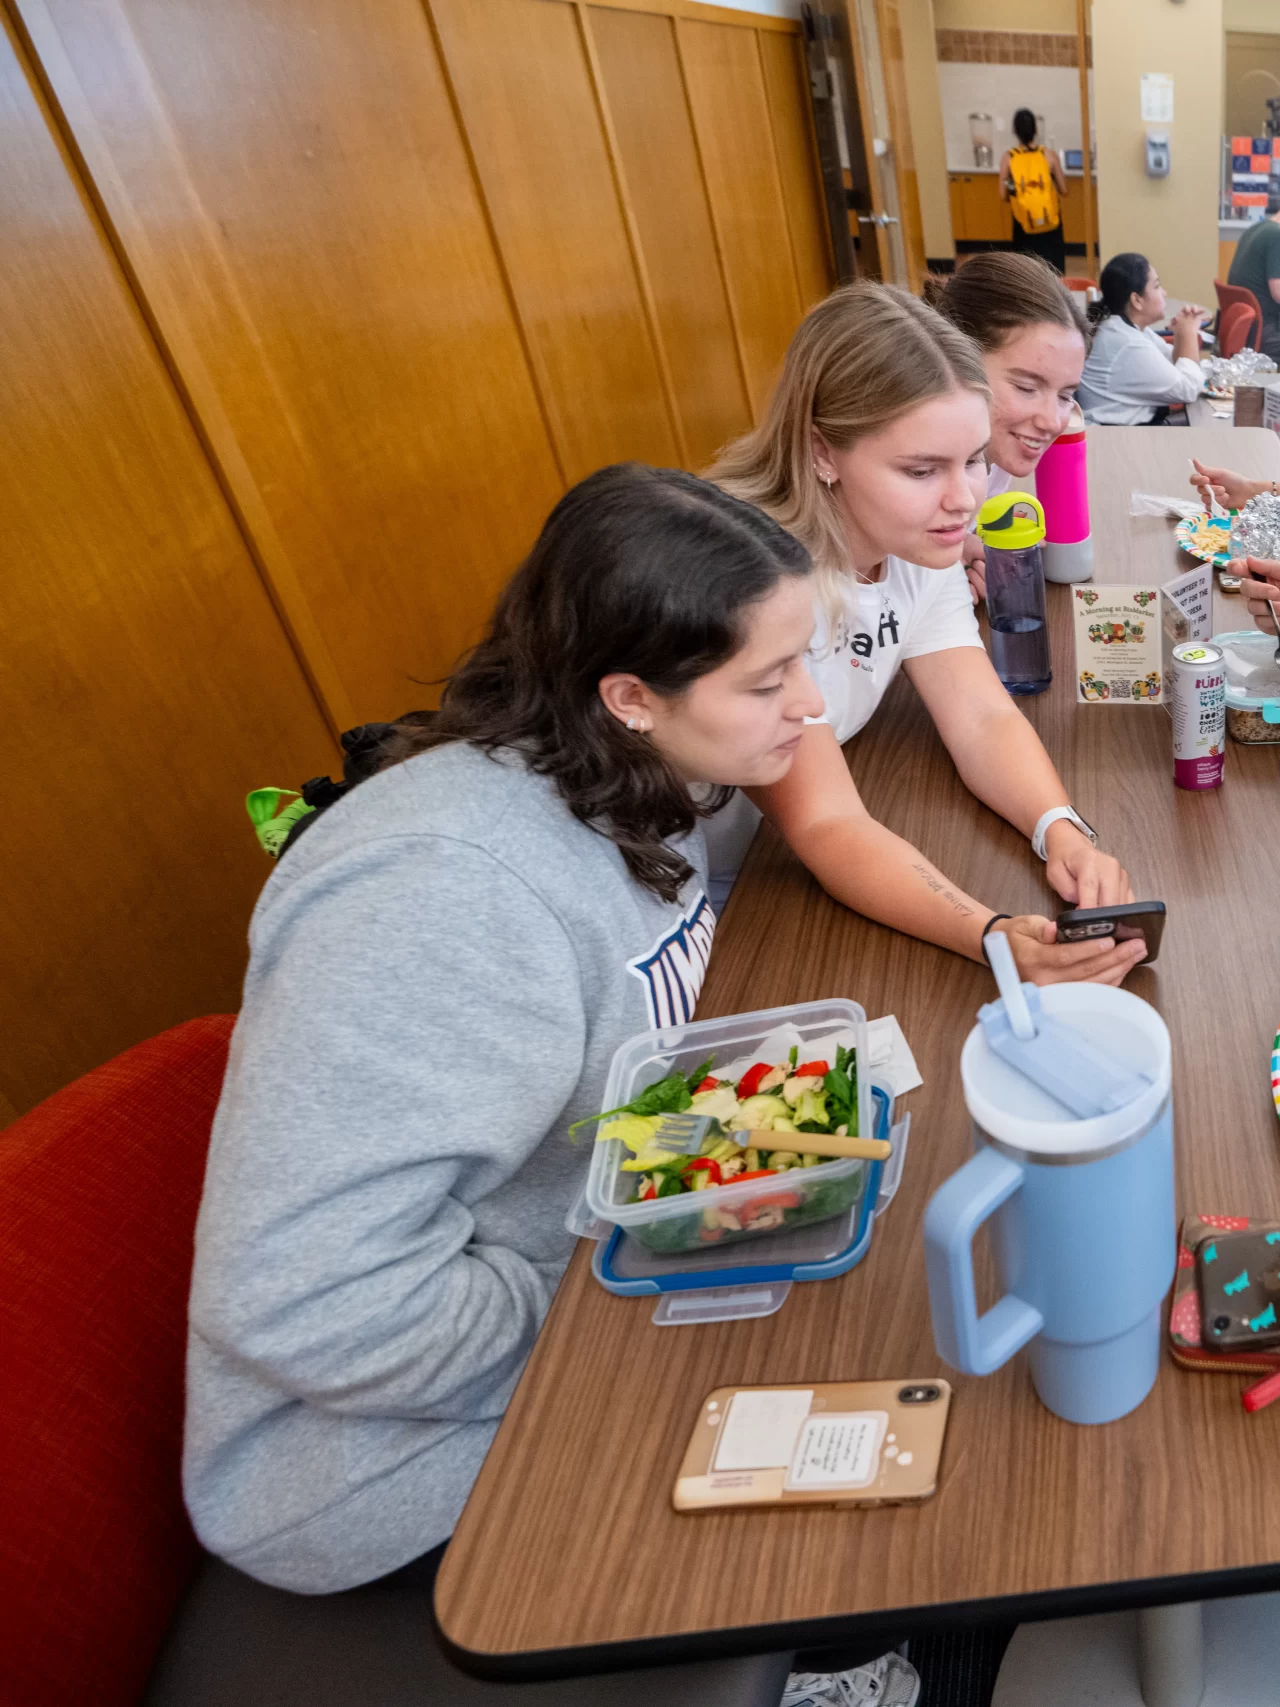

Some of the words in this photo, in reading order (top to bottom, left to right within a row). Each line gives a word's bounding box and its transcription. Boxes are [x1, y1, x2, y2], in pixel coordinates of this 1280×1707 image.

[1199, 577, 1206, 586] TO
[1199, 588, 1208, 598] THE
[1085, 606, 1114, 615] Morning
